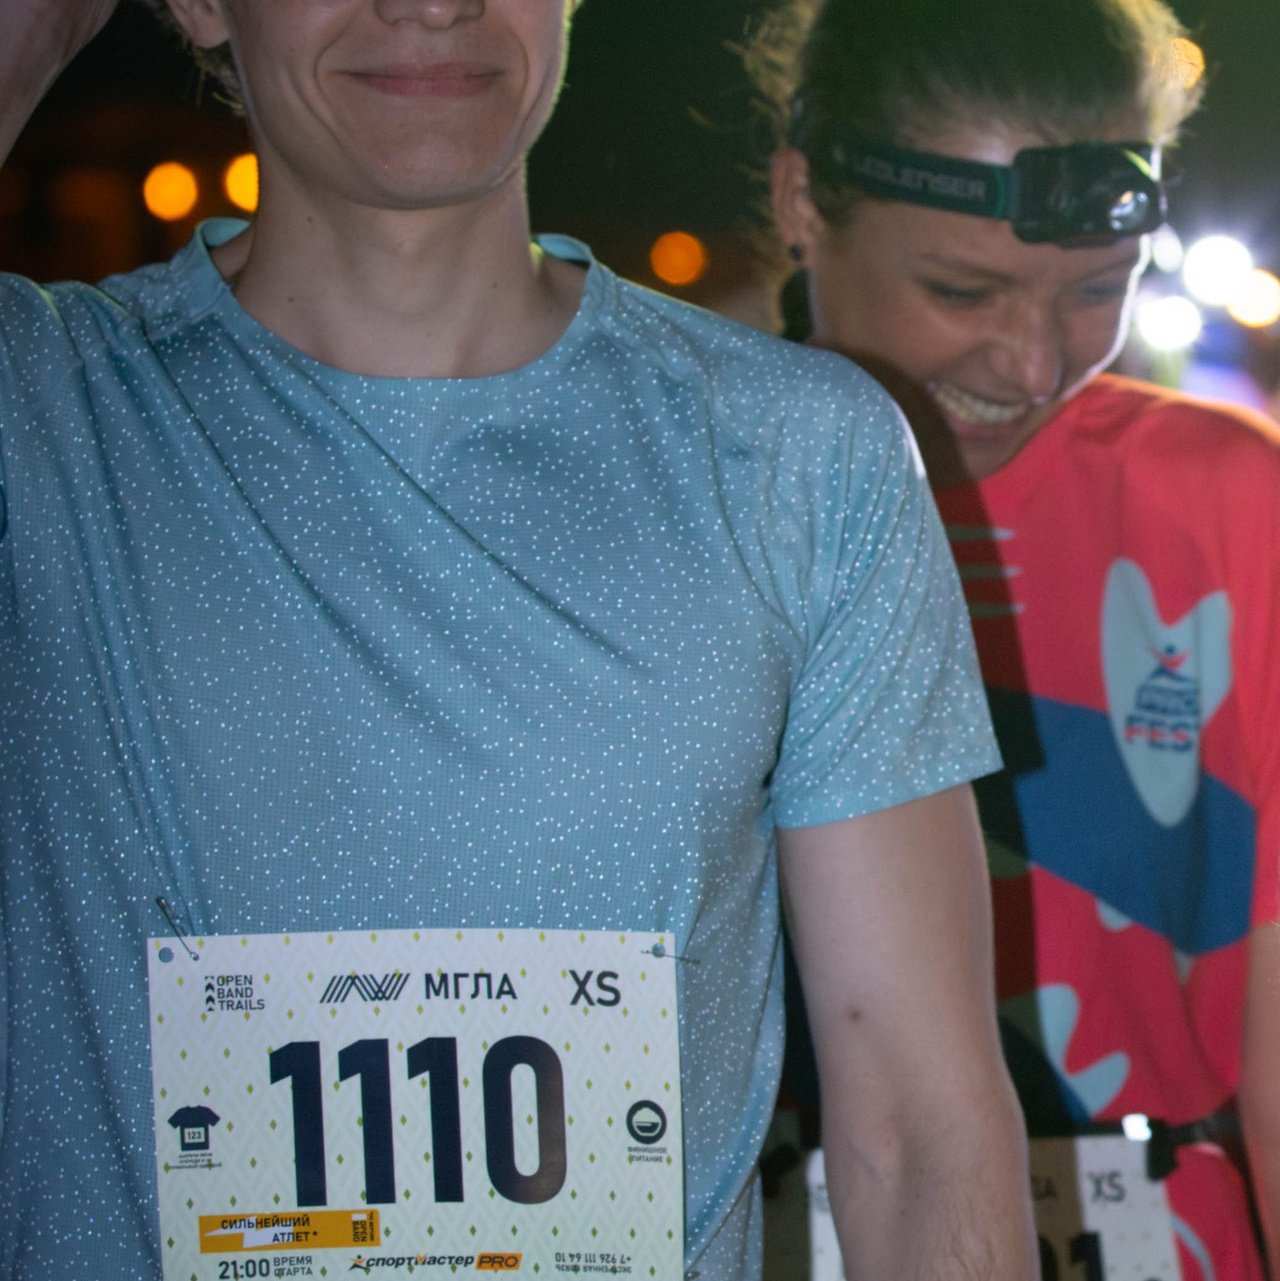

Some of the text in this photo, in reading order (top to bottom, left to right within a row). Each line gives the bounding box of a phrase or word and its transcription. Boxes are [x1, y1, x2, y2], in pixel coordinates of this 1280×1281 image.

[217, 975, 253, 987] OPEN
[425, 972, 518, 1000] МГЛА
[569, 969, 622, 1007] XS
[216, 987, 254, 999] BAND
[217, 998, 265, 1011] TRAILS
[269, 1035, 567, 1207] 1110
[187, 1131, 202, 1140] 123
[1088, 1170, 1125, 1202] XS
[220, 1214, 310, 1230] СИЛЬНЕЙШИЙ
[352, 1220, 360, 1242] BAND
[359, 1220, 367, 1242] OPEN
[273, 1256, 313, 1267] ВРЕМЯ
[478, 1255, 518, 1268] PRO
[555, 1252, 631, 1264] +7 926 111 64 10
[218, 1258, 271, 1280] 21:00
[273, 1266, 313, 1277] СТАРТА
